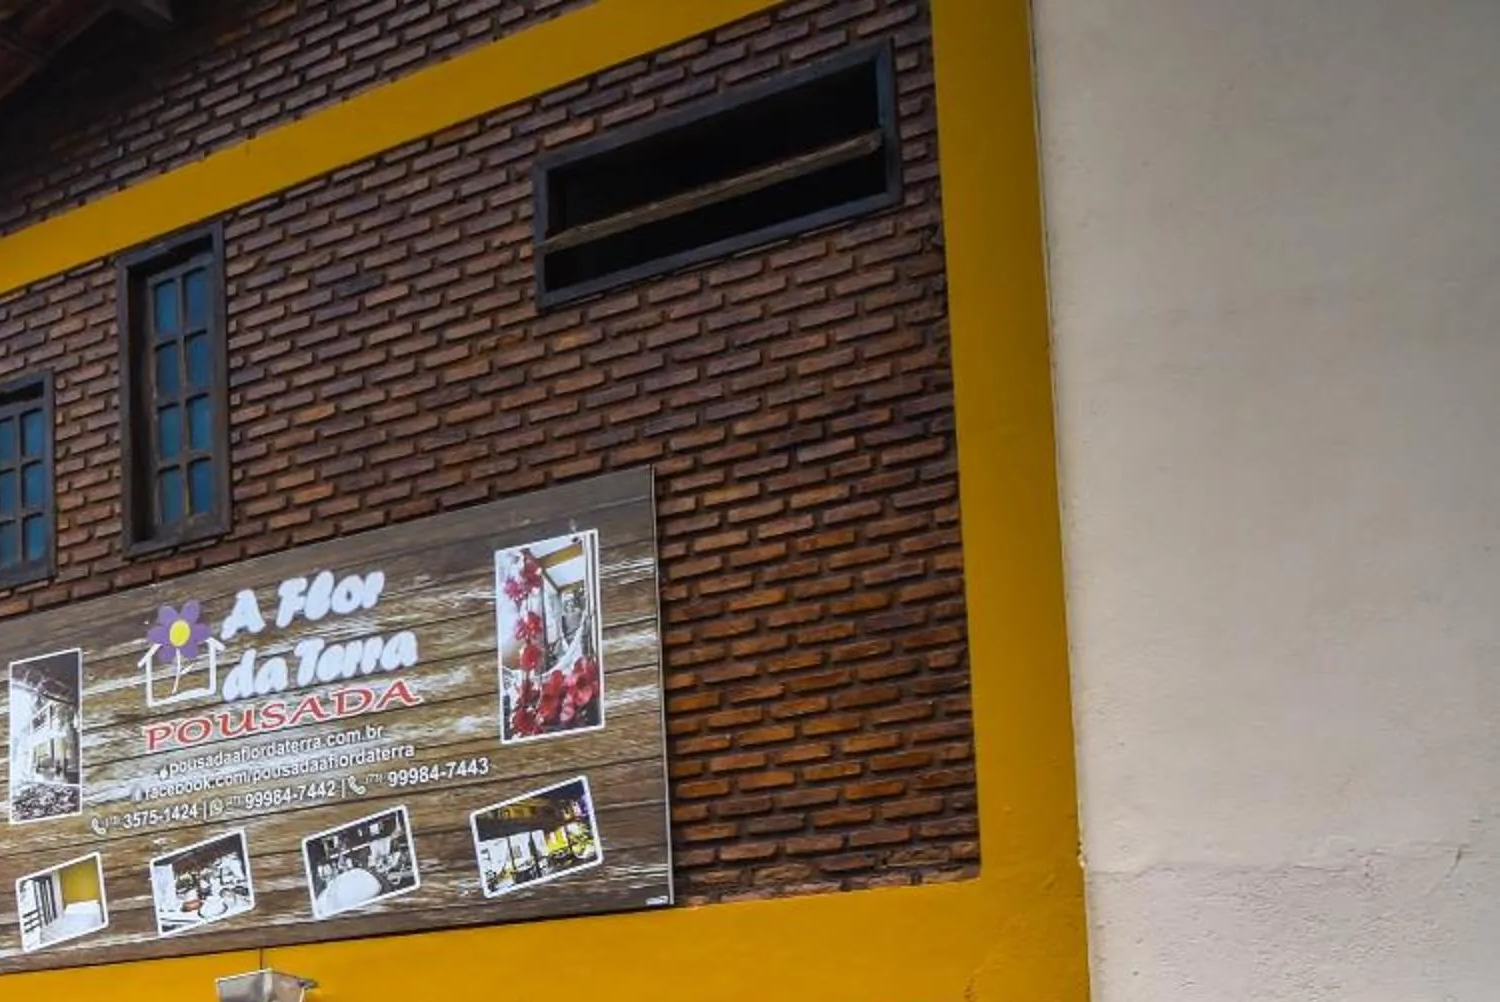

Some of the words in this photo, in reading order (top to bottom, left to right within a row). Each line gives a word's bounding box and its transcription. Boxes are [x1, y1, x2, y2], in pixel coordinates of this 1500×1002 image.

[221, 589, 266, 641] A
[276, 570, 385, 628] Flor
[222, 648, 289, 701] da
[293, 630, 419, 687] Terra
[142, 678, 423, 754] POUSADA
[123, 803, 198, 829] 3575-1424
[387, 757, 490, 787] 99984-7443
